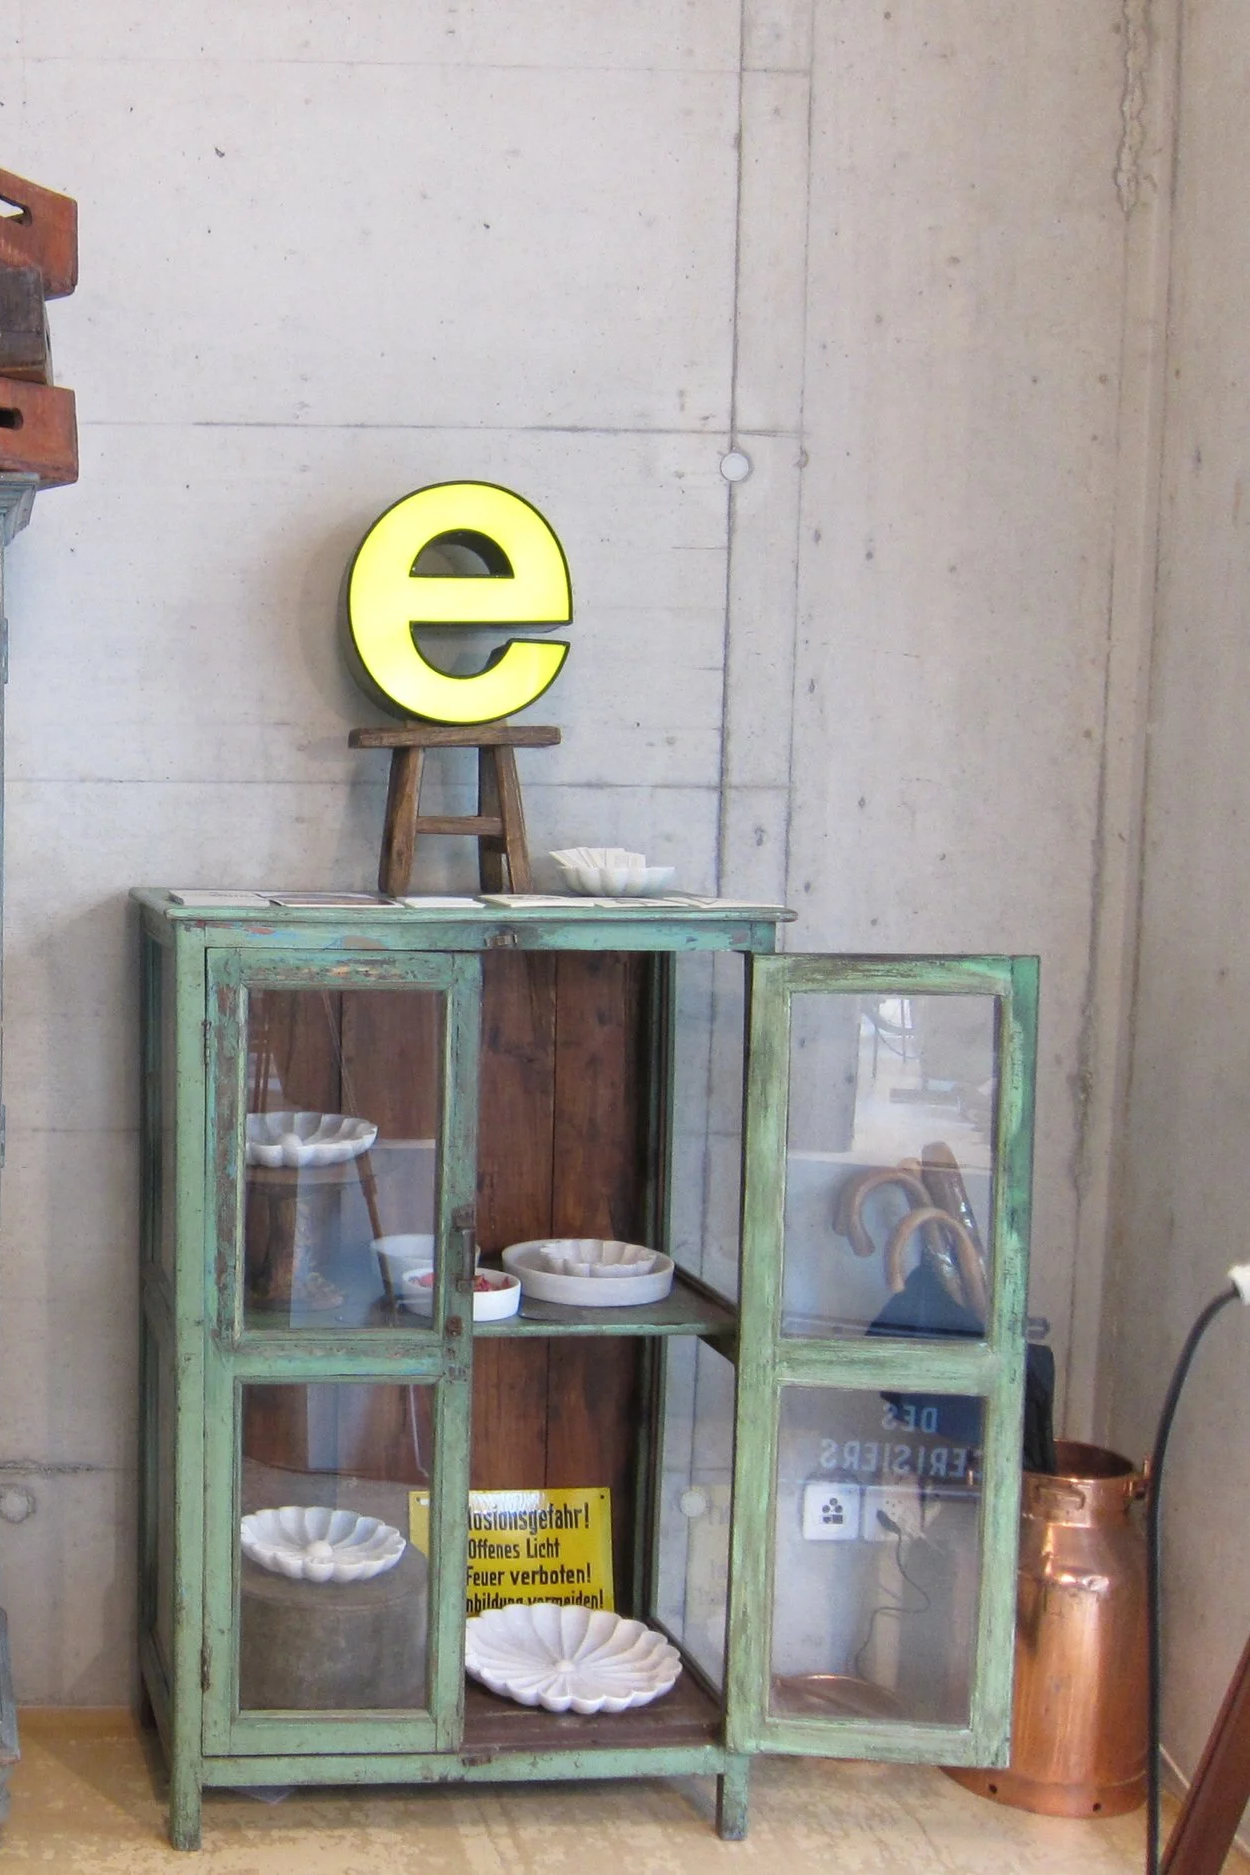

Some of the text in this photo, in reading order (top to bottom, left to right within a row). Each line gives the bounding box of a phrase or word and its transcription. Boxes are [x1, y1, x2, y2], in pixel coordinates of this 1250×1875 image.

[347, 480, 572, 726] e
[467, 1503, 590, 1535] losionsgefahr!
[468, 1537, 561, 1559] Offenes Licht
[466, 1563, 591, 1586] Feuer verboten!
